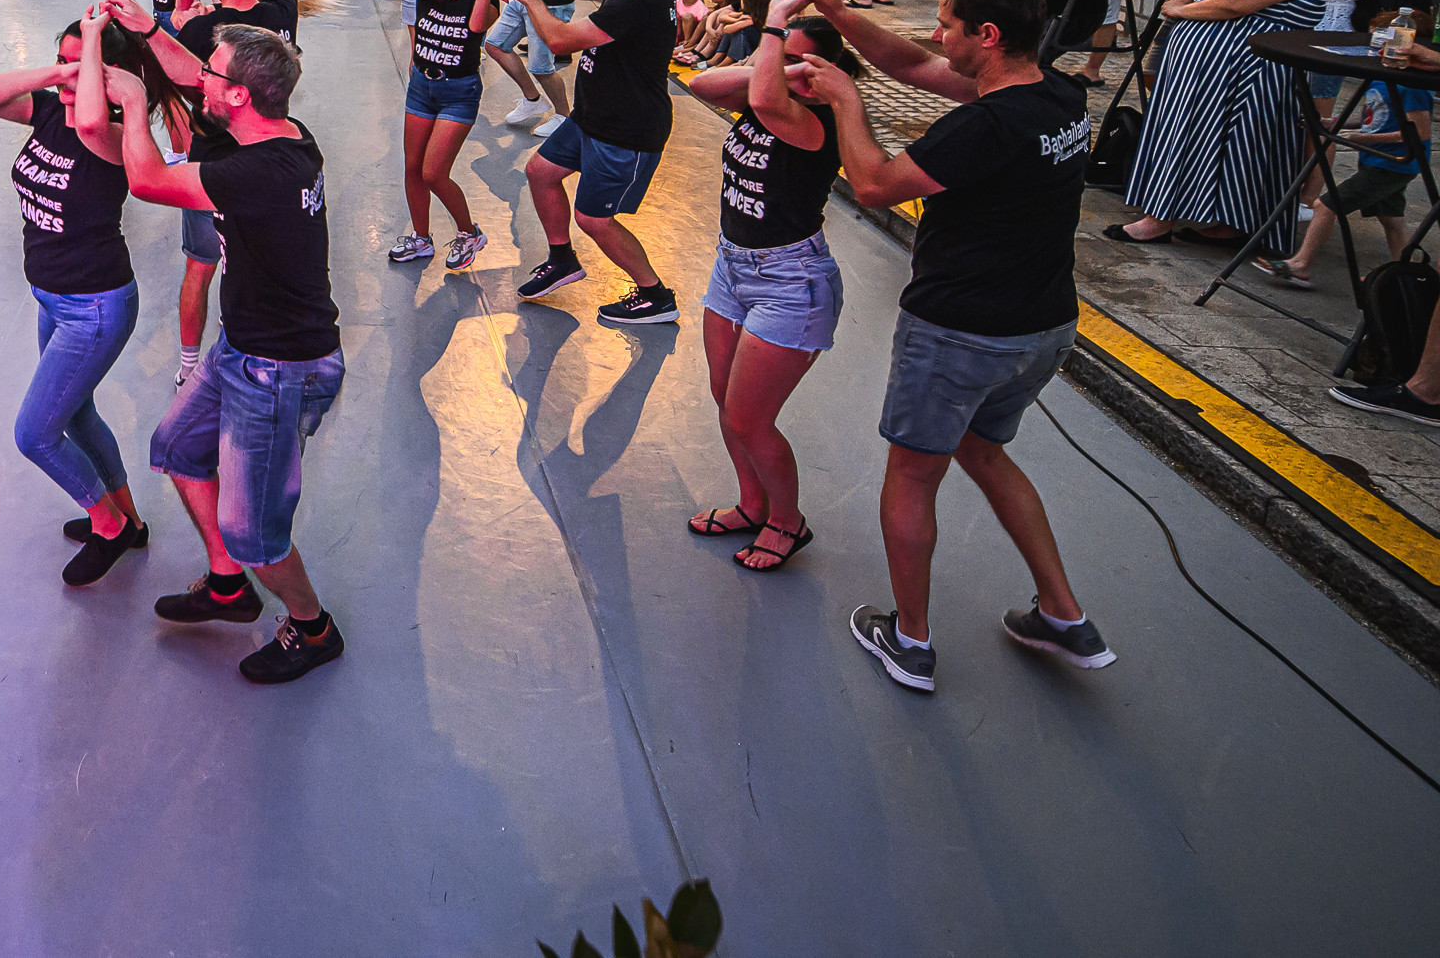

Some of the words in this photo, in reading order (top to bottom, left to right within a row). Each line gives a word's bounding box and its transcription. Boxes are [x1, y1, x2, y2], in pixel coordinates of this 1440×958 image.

[428, 8, 444, 22] TAKE
[444, 14, 466, 24] MORE
[418, 17, 469, 39] CHANCES
[415, 43, 461, 66] DANCES
[441, 41, 465, 53] MORE
[19, 197, 64, 233] ANCES
